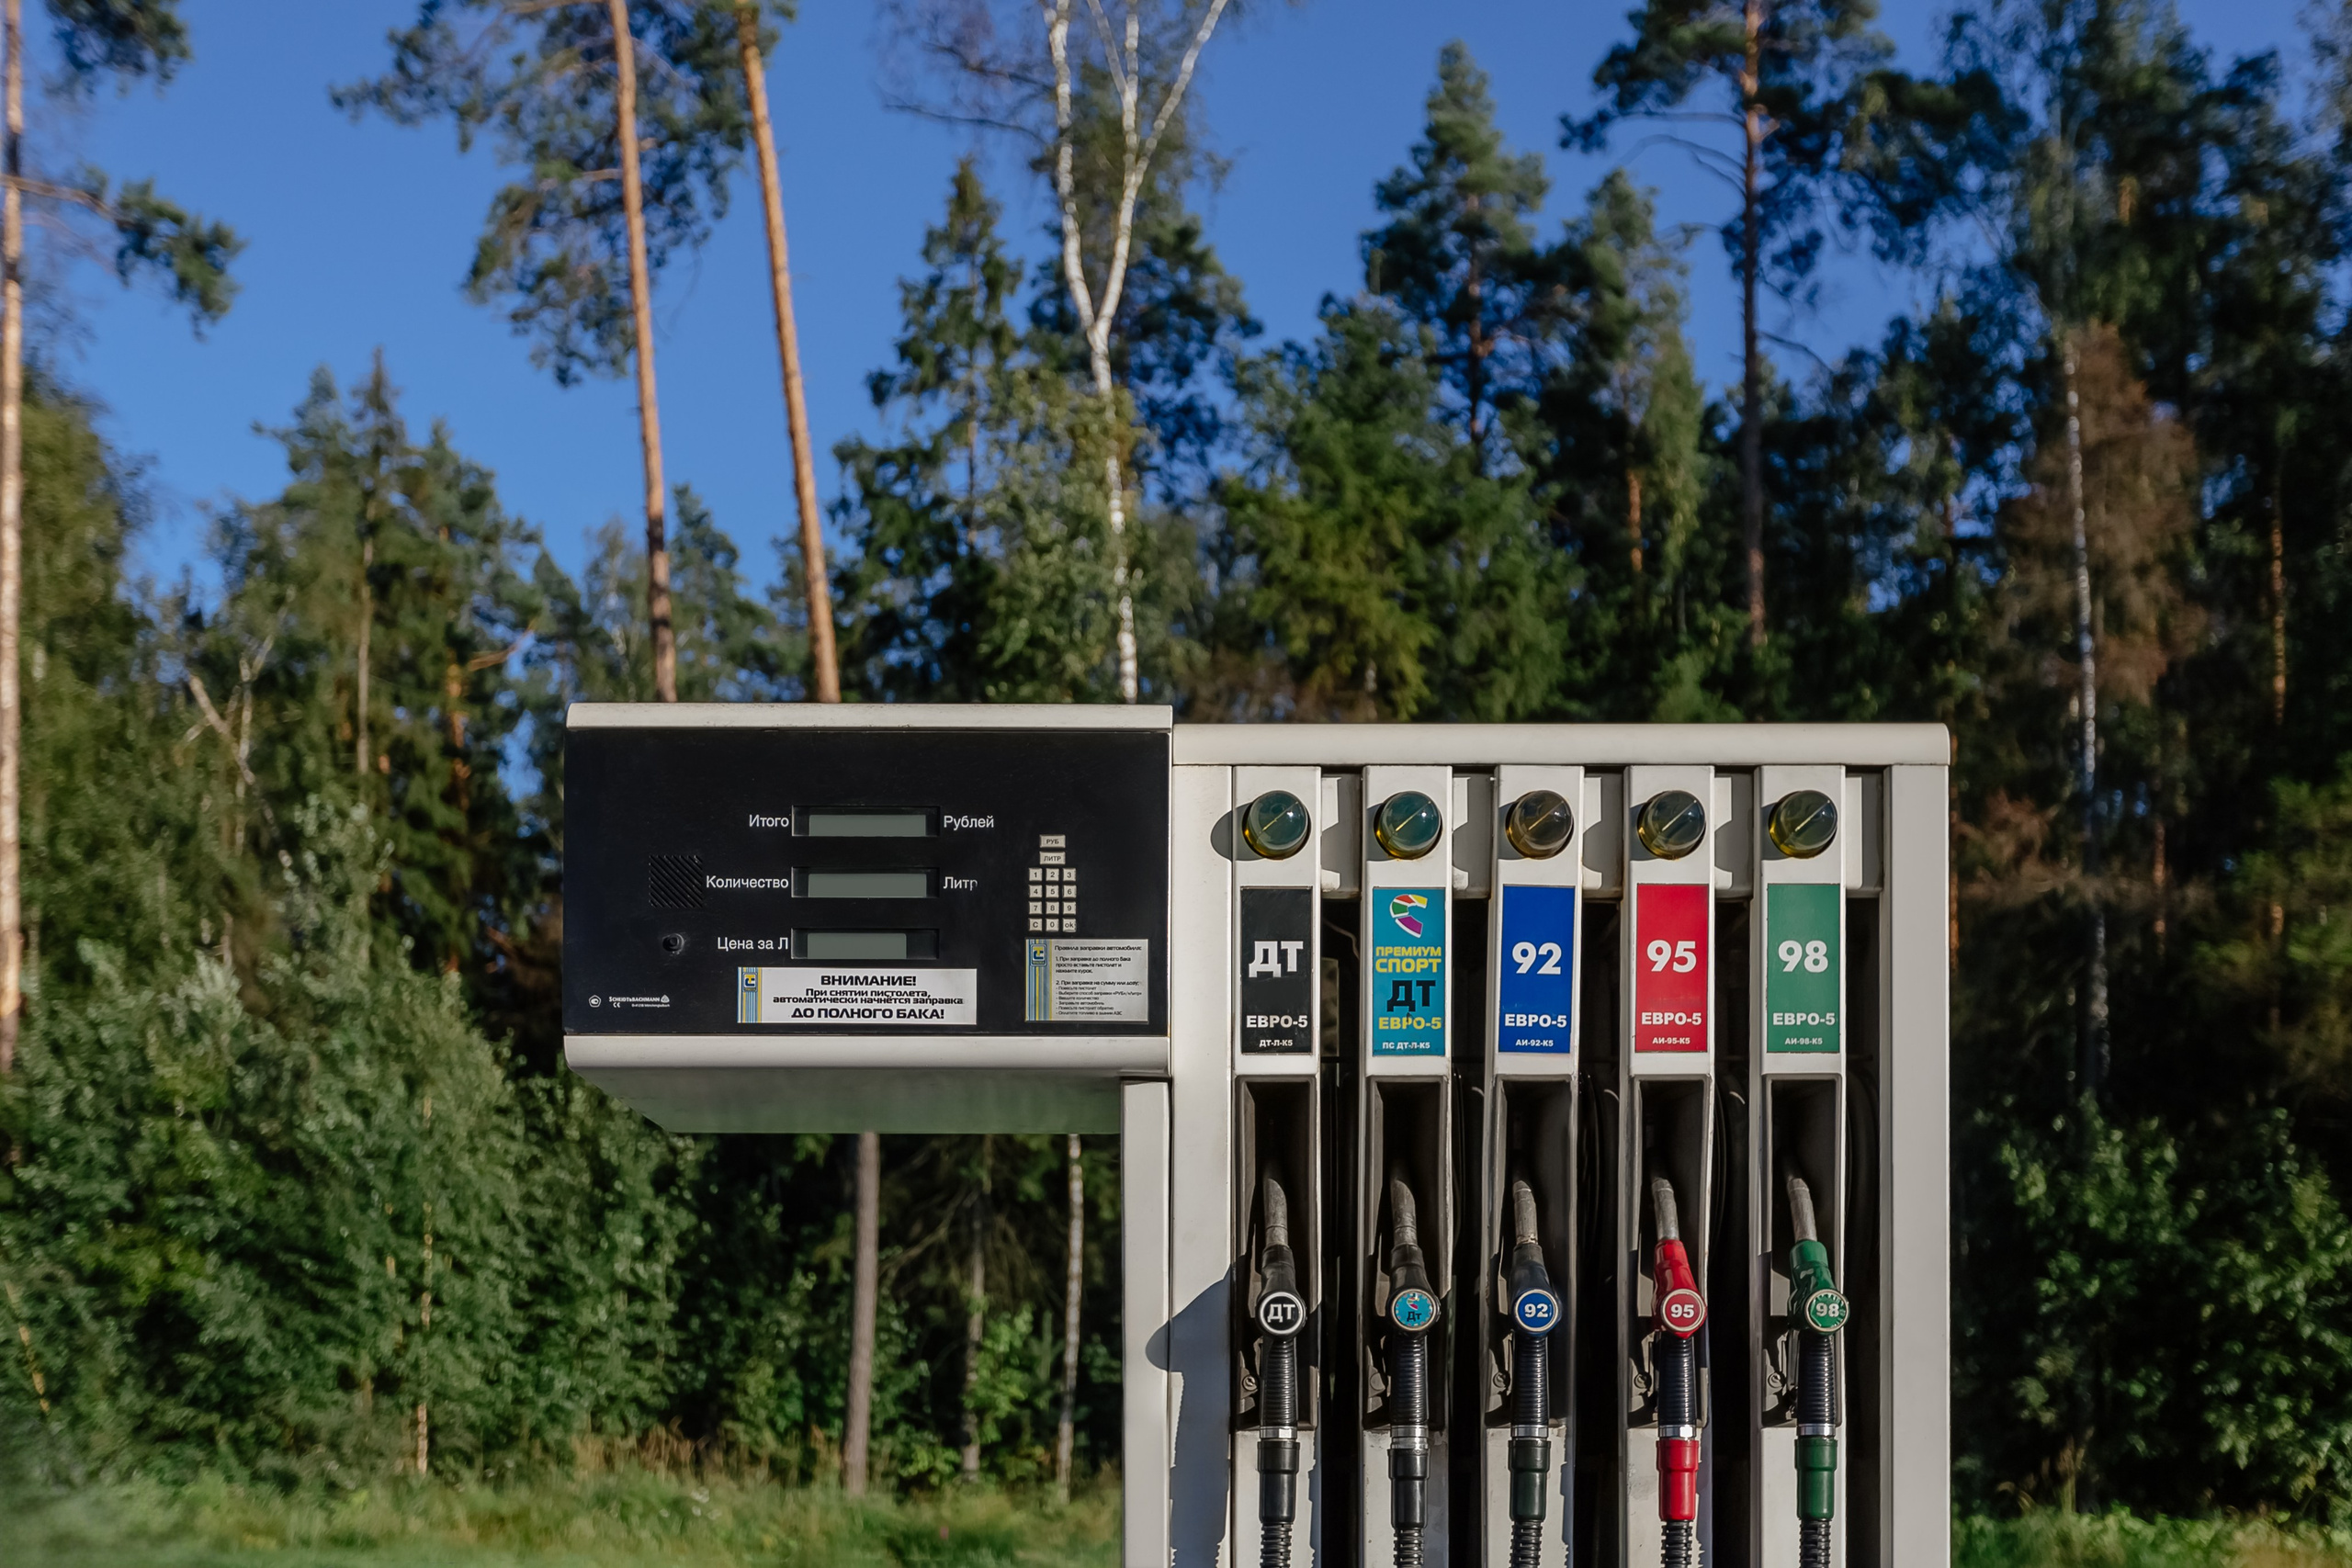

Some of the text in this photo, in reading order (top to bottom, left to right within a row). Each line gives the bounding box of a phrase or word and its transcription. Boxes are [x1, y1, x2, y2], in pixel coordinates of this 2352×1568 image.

[749, 814, 789, 828] Итого
[944, 815, 994, 830] Рублей
[706, 875, 789, 889] Количество
[943, 876, 978, 891] Литр
[717, 937, 789, 952] Цена за Л
[1375, 946, 1442, 957] ПРЕМИУМ
[1249, 941, 1304, 978] ДТ
[1511, 942, 1562, 975] 92
[1646, 939, 1697, 973] 95
[1778, 940, 1829, 973] 98
[1375, 958, 1442, 973] СПОРТ
[820, 976, 917, 987] ВНИМАНИЕ!
[806, 988, 827, 998] При
[870, 989, 931, 998] пистолета,
[1386, 979, 1436, 1012] ДТ
[912, 997, 964, 1006] заправка
[791, 1008, 944, 1020] ДО ПОЛНОГО БАКА!
[1504, 1013, 1567, 1028] ЕВРО-5
[1641, 1012, 1702, 1026] ЕВРО-5
[1772, 1012, 1836, 1026] ЕВРО-5
[1246, 1015, 1308, 1028] ЕВРО-5
[1378, 1017, 1442, 1030] ЕВРО-5
[1259, 1039, 1294, 1047] ДТ-Л-К5
[1396, 1042, 1430, 1050] ДТ-Л-К5
[1515, 1039, 1555, 1047] АИ-92-К5
[1652, 1037, 1690, 1045] АИ-95-К5
[1784, 1037, 1823, 1045] АИ-98-К5
[1267, 1303, 1296, 1324] ДТ
[1524, 1303, 1548, 1318] 92
[1670, 1304, 1695, 1318] 95
[1815, 1303, 1839, 1317] 98
